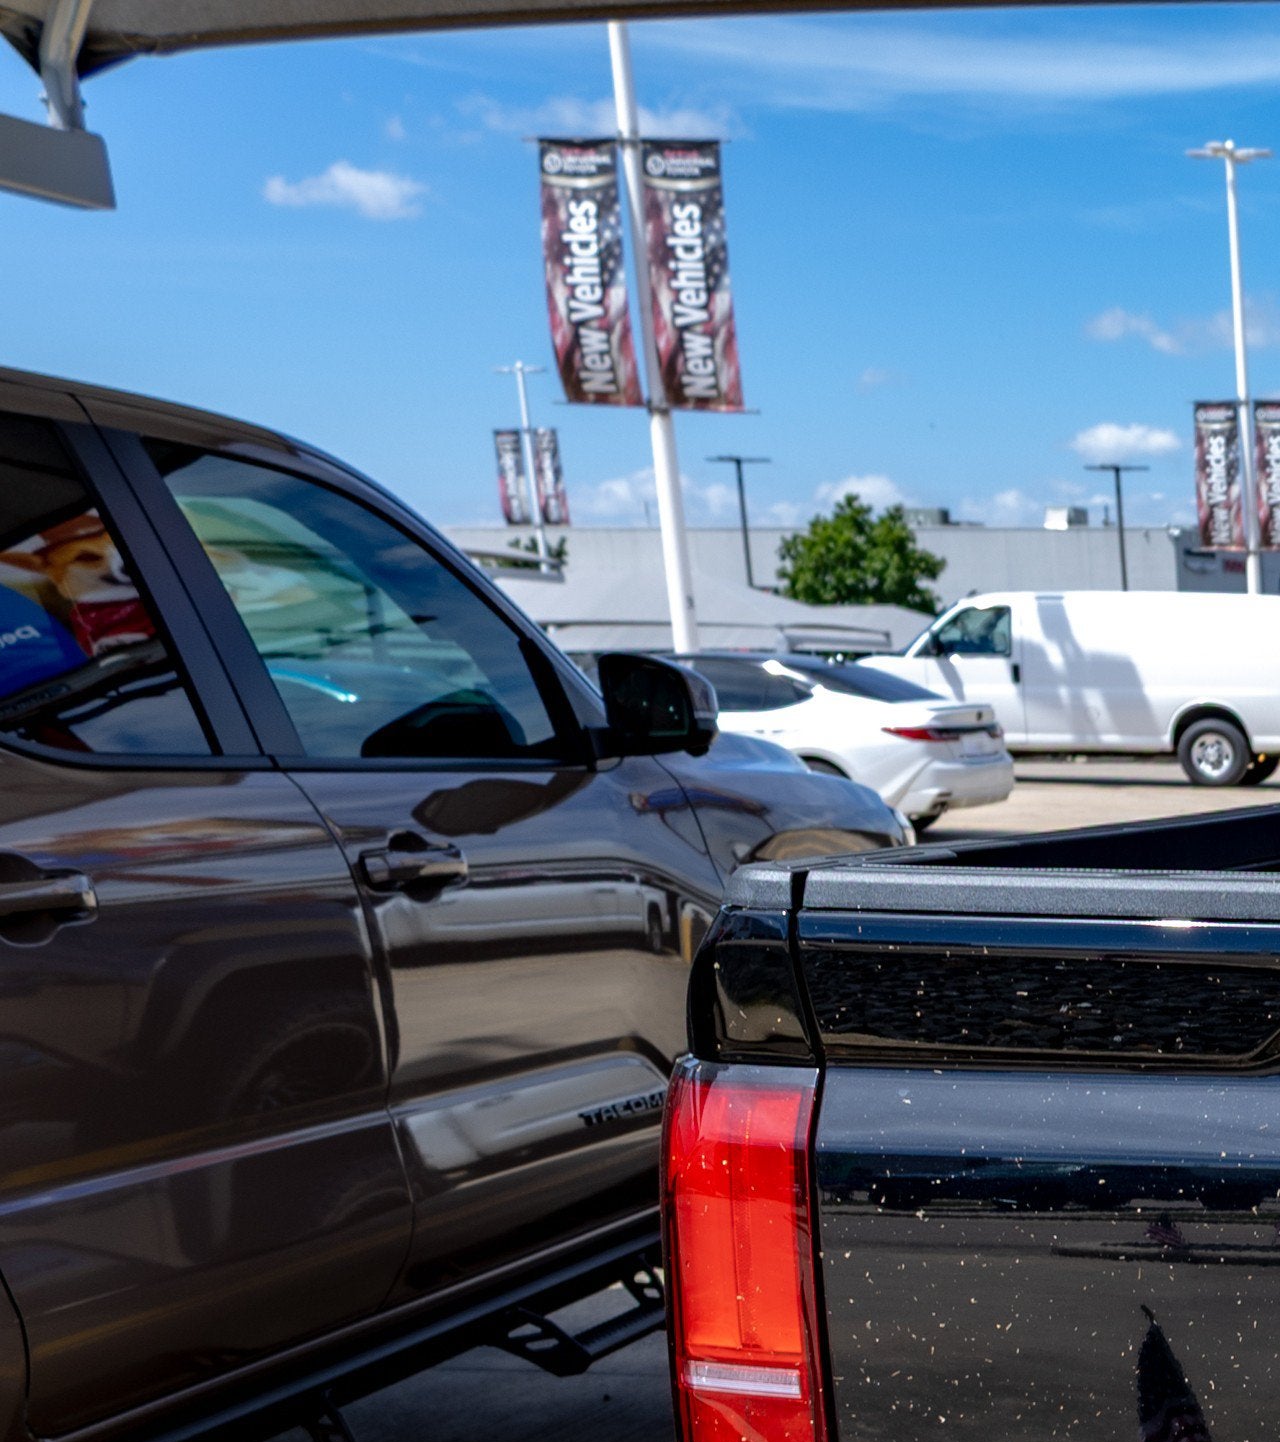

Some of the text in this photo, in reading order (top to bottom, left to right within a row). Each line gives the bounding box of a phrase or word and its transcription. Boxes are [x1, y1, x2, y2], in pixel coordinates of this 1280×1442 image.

[561, 199, 605, 323] Vehicles
[666, 202, 709, 328] Vehicles
[579, 327, 618, 394] New
[680, 331, 719, 398] New
[1205, 435, 1228, 504] Vehicles
[1211, 506, 1230, 544] New
